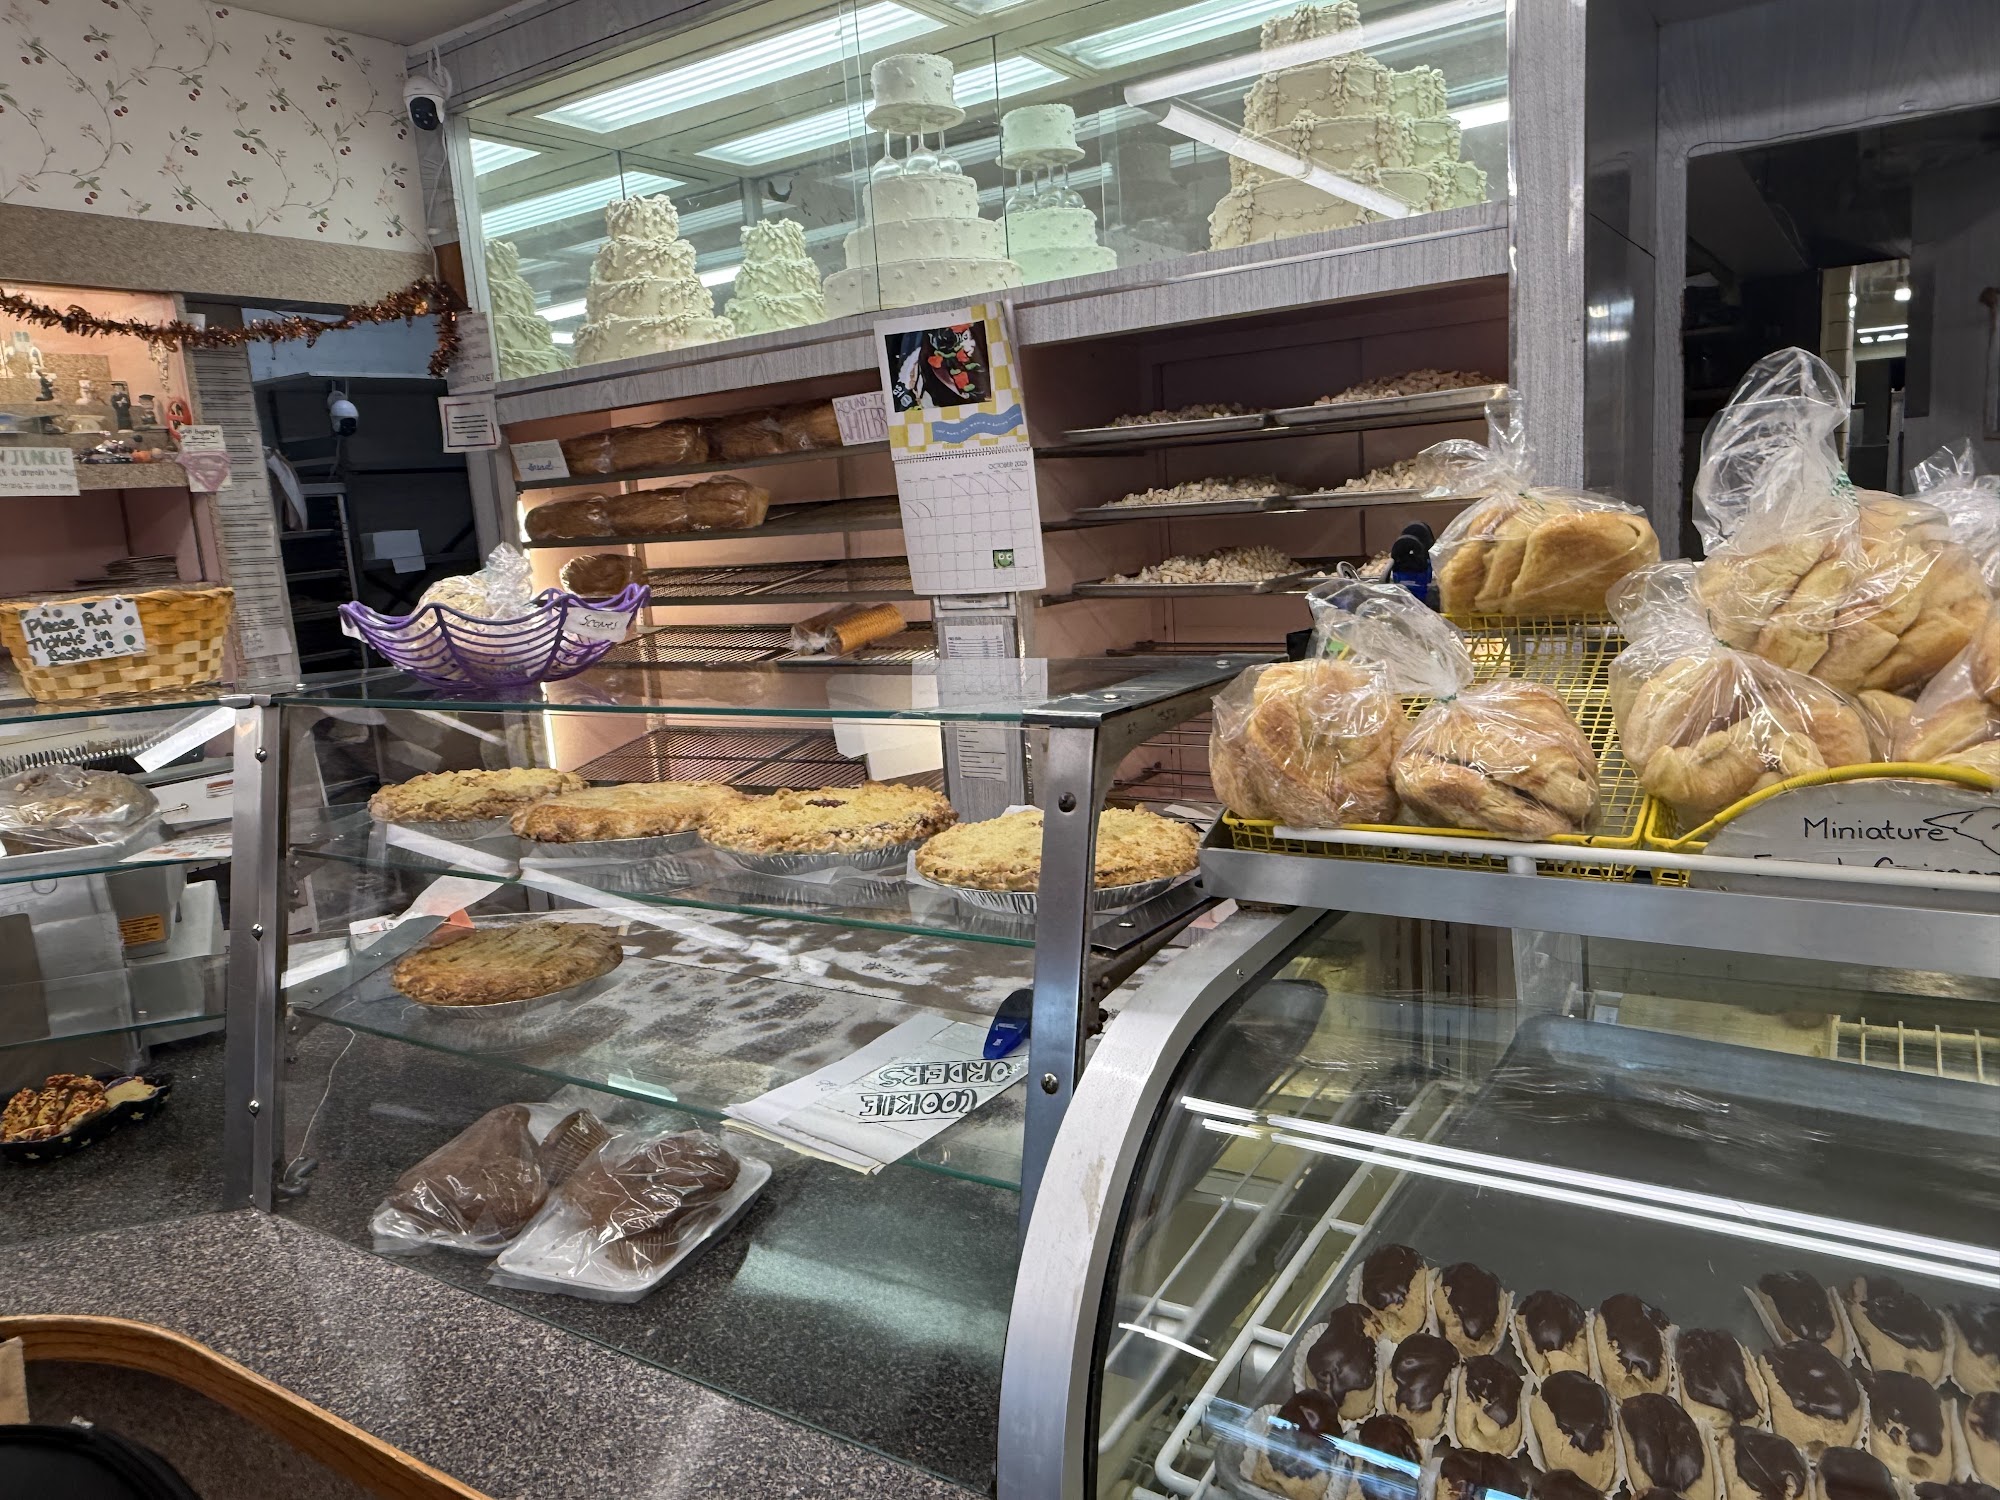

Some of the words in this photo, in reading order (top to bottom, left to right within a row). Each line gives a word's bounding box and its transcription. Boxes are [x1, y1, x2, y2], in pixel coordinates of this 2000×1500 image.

[24, 617, 79, 638] Please
[81, 609, 113, 626] Put
[92, 628, 113, 642] in
[1803, 816, 1949, 841] Miniature
[878, 1061, 1013, 1088] ORDERS
[859, 1089, 978, 1117] COOKIE
